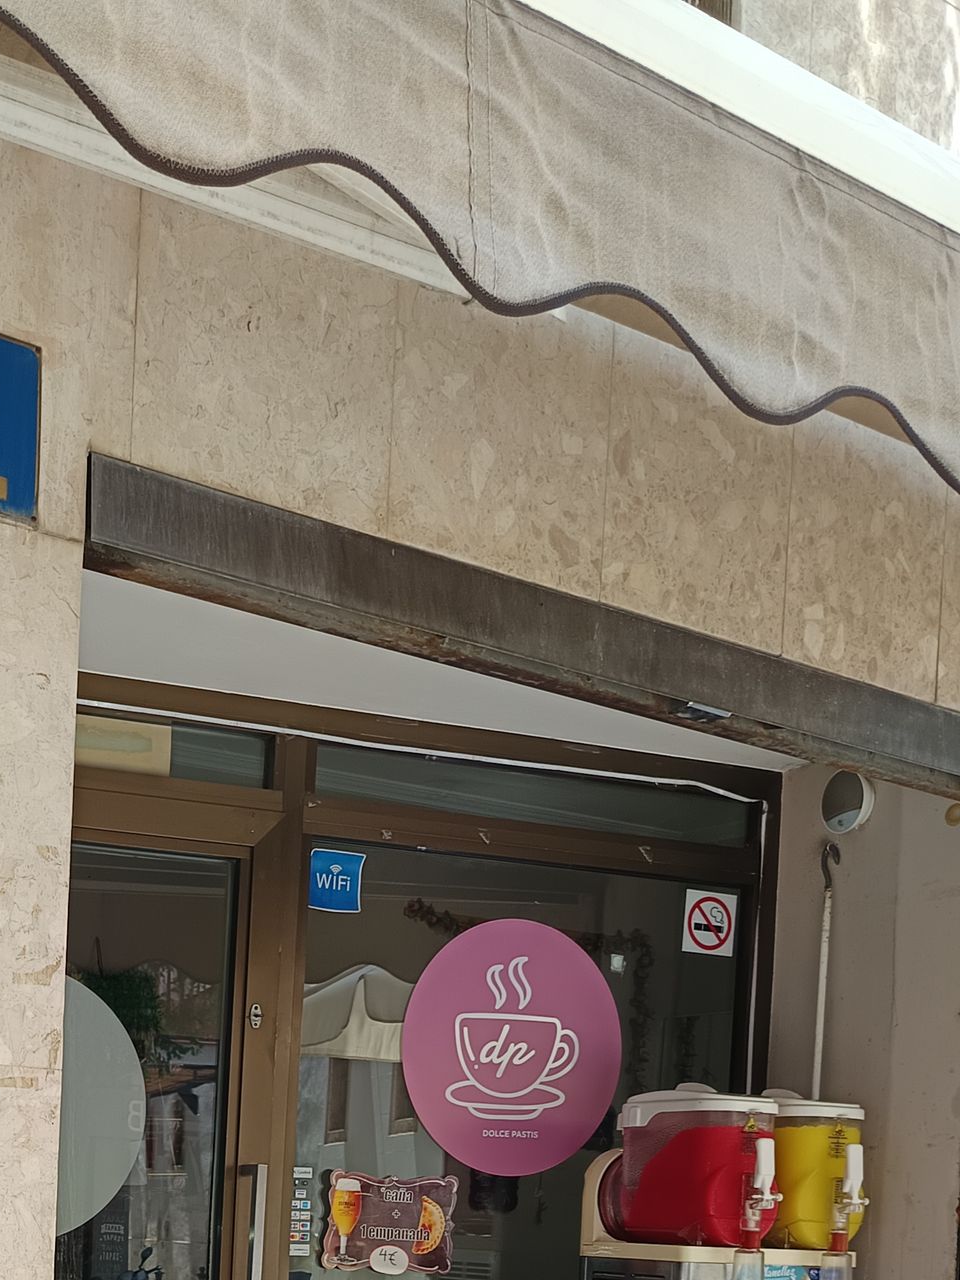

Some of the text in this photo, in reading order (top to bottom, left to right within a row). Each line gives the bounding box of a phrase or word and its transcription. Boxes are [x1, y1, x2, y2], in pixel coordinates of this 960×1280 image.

[316, 872, 351, 891] WiFi
[482, 1129, 538, 1138] DOLCE PASTIS
[379, 1248, 398, 1266] 4€
